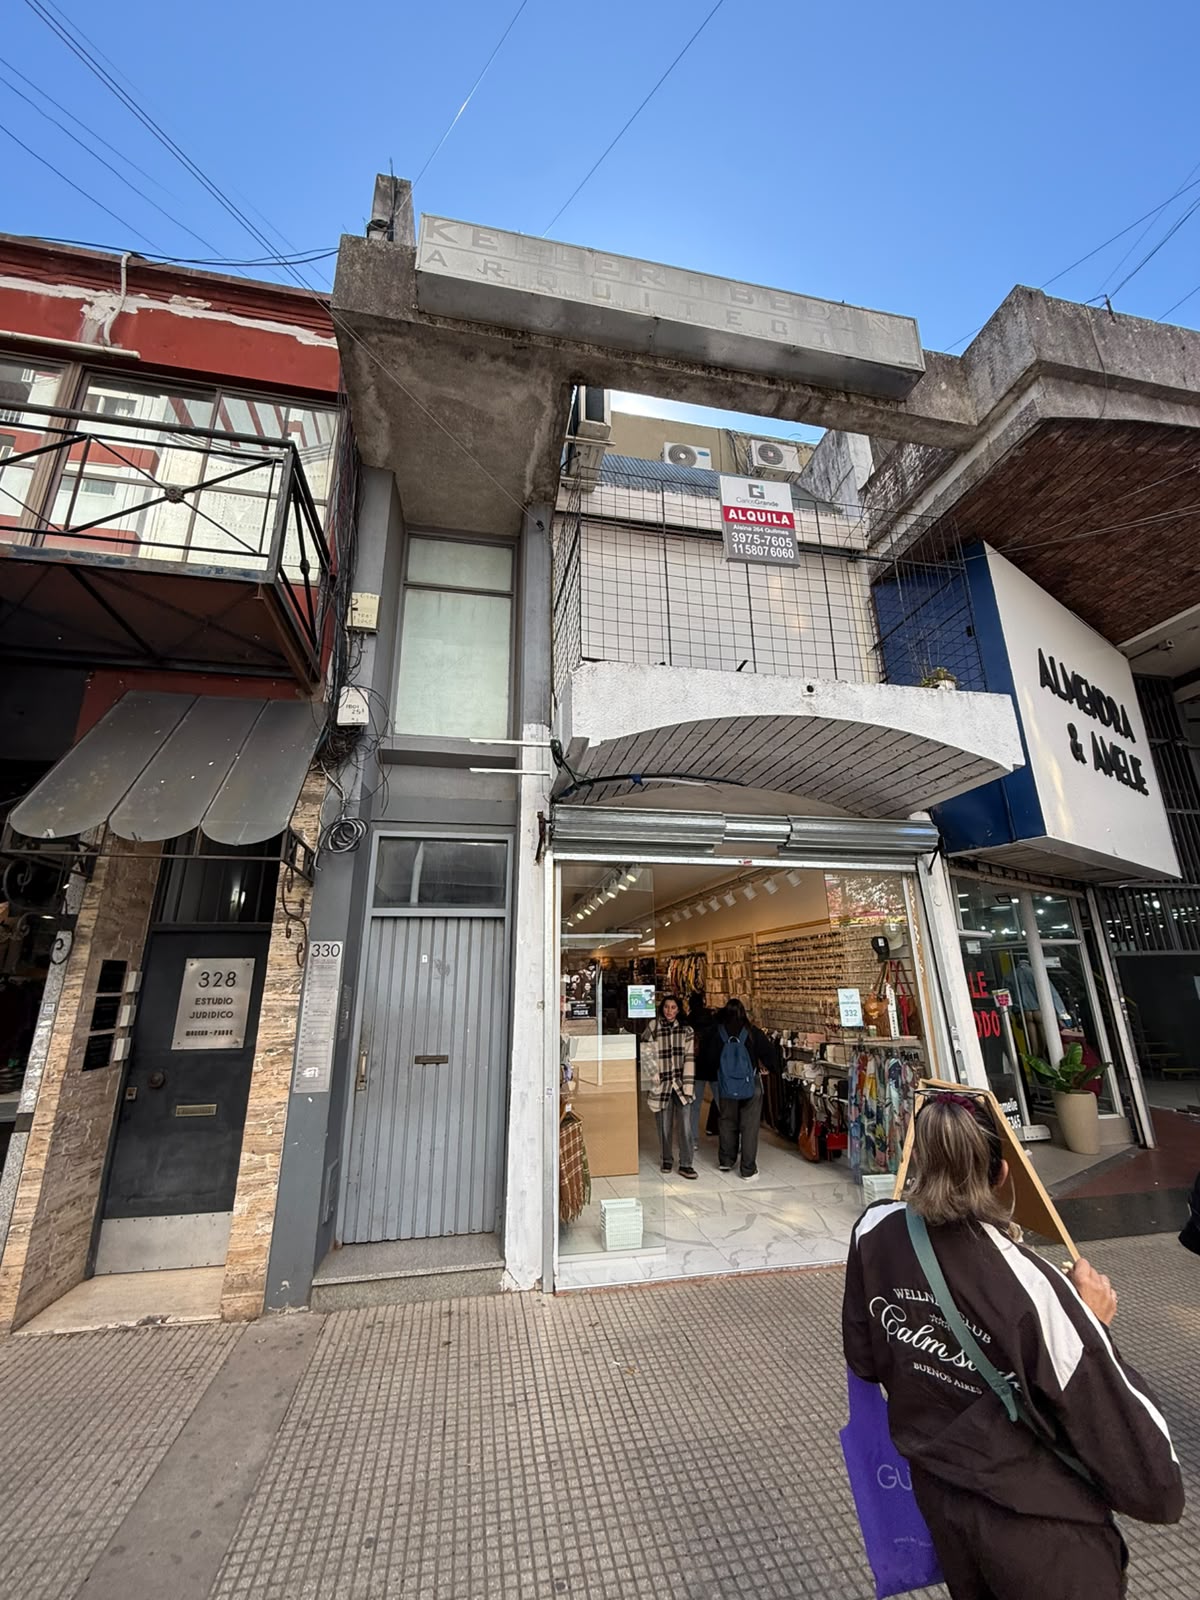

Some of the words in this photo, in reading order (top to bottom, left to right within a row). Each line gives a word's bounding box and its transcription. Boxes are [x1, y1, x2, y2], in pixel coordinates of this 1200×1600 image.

[425, 217, 667, 286] KELLER
[728, 508, 790, 525] ALQUILA
[731, 532, 793, 547] 3975-7605
[1038, 648, 1136, 743] ALMENDRA
[1067, 723, 1087, 764] &
[311, 943, 341, 958] 330
[198, 971, 237, 988] 328
[194, 997, 234, 1006] ESTUDIO
[189, 1010, 234, 1019] JURIDICO
[844, 1009, 858, 1017] 332
[869, 1296, 949, 1359] Calm
[913, 1361, 953, 1384] BUENOS
[953, 1379, 983, 1395] AIRES
